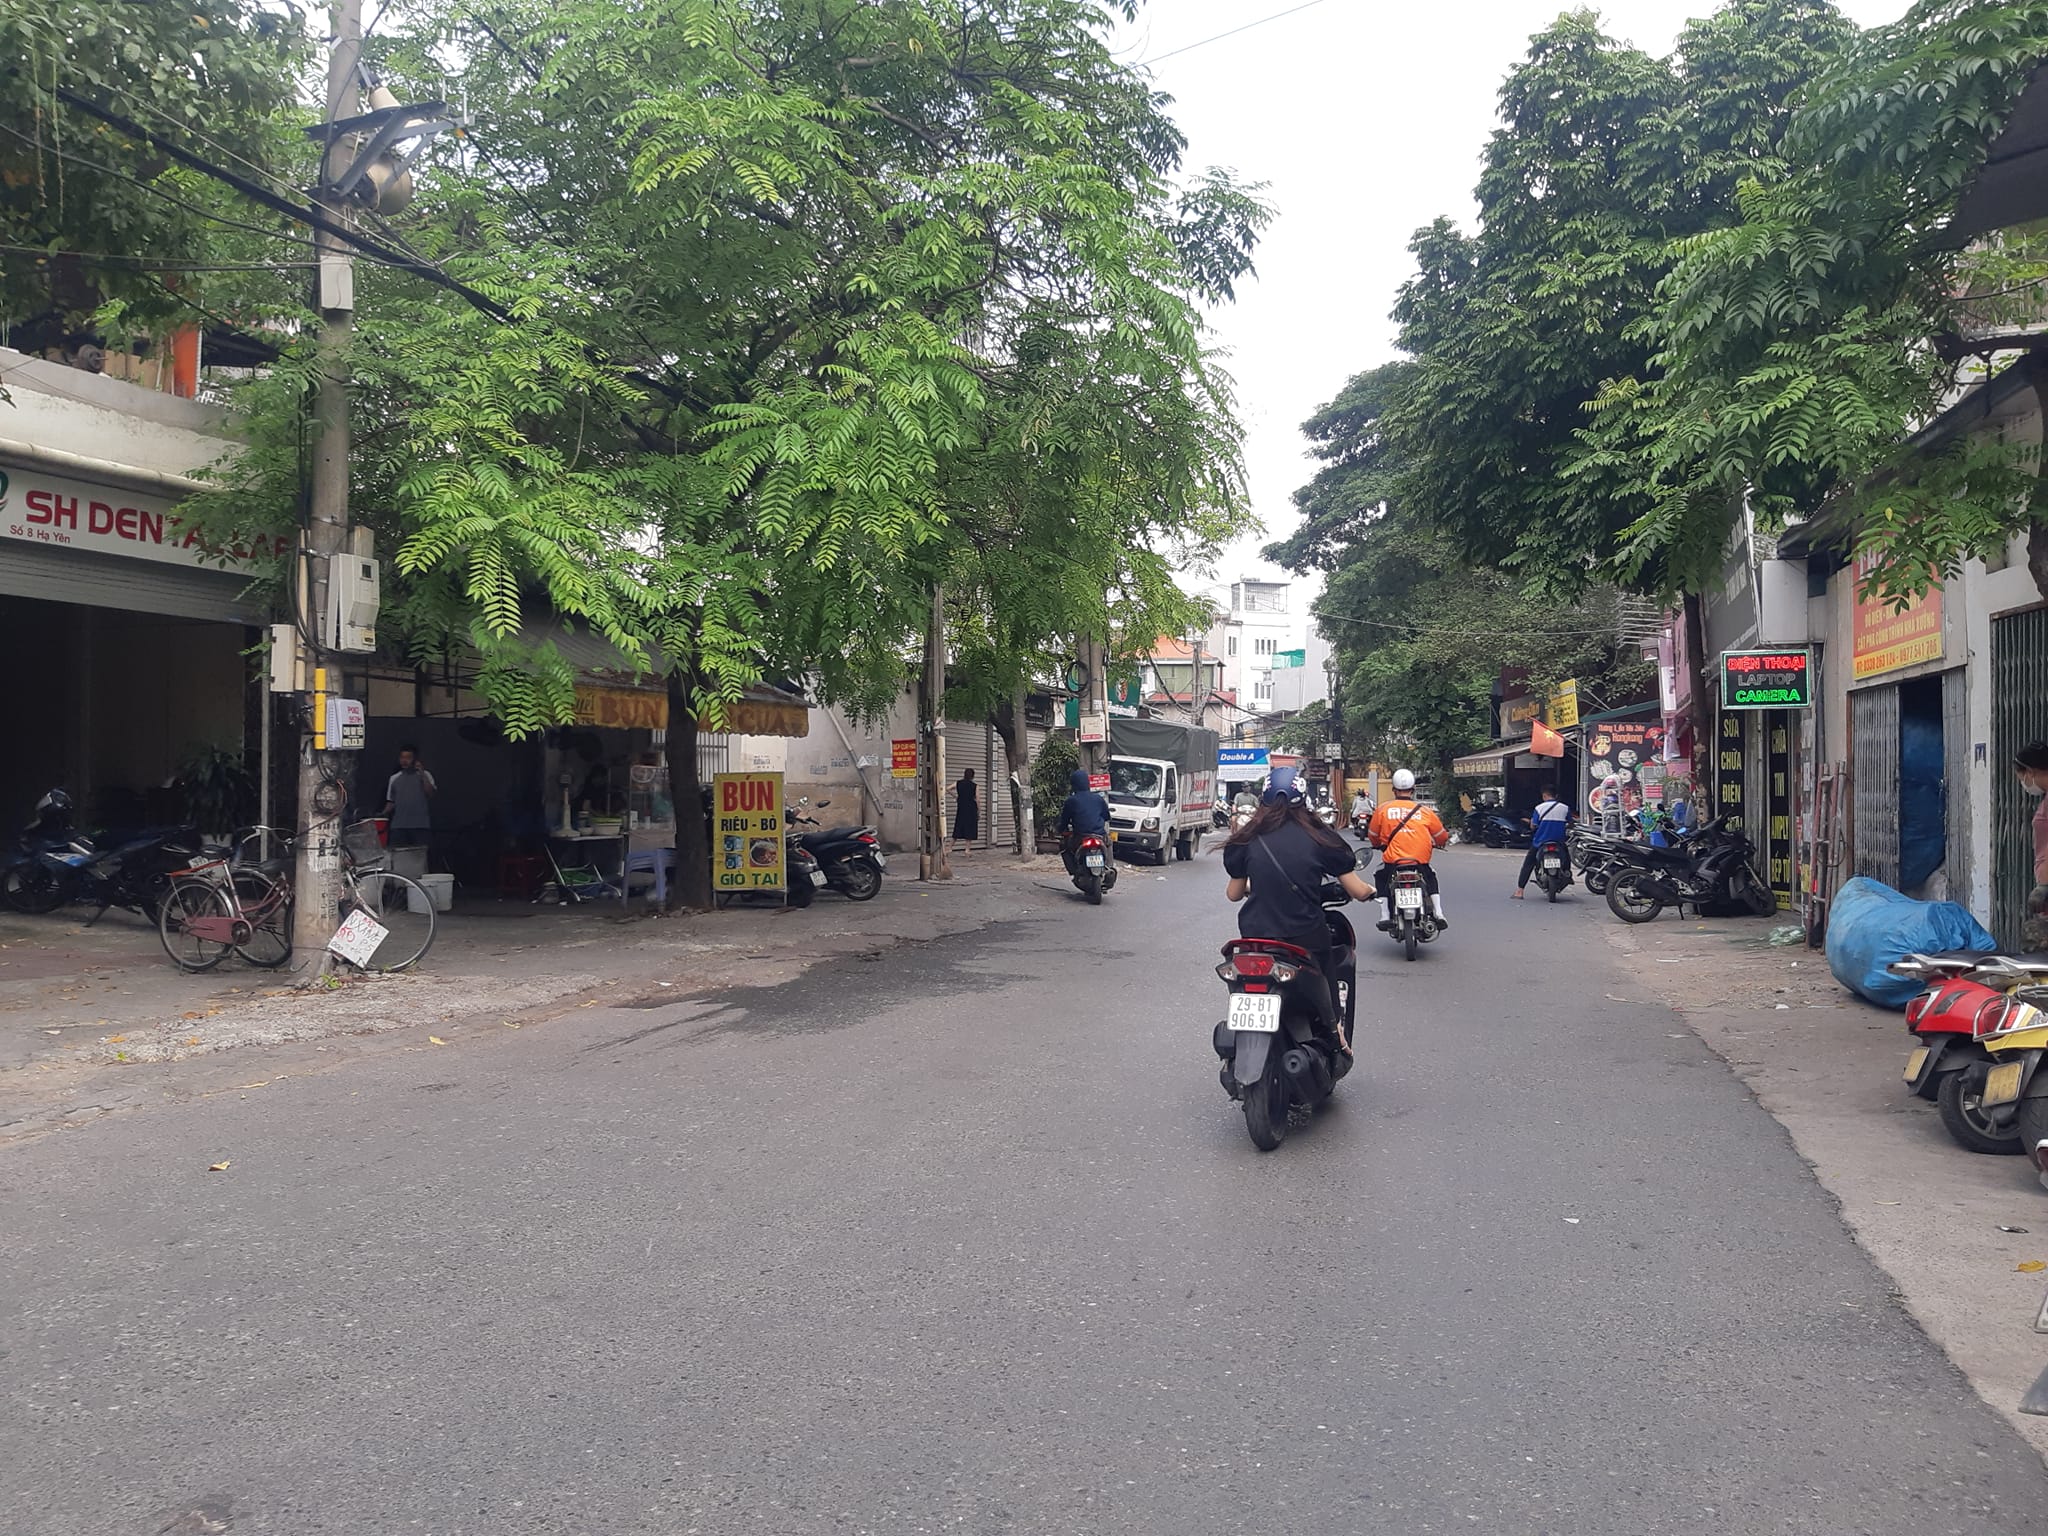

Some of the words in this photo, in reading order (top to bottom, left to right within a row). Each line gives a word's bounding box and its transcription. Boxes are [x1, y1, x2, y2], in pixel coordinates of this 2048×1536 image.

[26, 490, 78, 530] SH
[27, 528, 33, 538] 8
[1728, 656, 1761, 673] ĐIỆN
[1762, 655, 1806, 672] THOẠI
[1738, 673, 1796, 687] LAPTOP
[1735, 688, 1801, 703] CAMERA
[1220, 753, 1247, 761] Double
[723, 775, 774, 812] BÚN
[1722, 780, 1741, 807] ĐIỆN
[721, 815, 748, 831] RIÊU
[760, 815, 777, 831] BÒ
[720, 870, 746, 886] GIÒ
[752, 873, 778, 886] TAI
[1237, 997, 1272, 1013] 29-B1
[1231, 1012, 1275, 1029] 906.91
